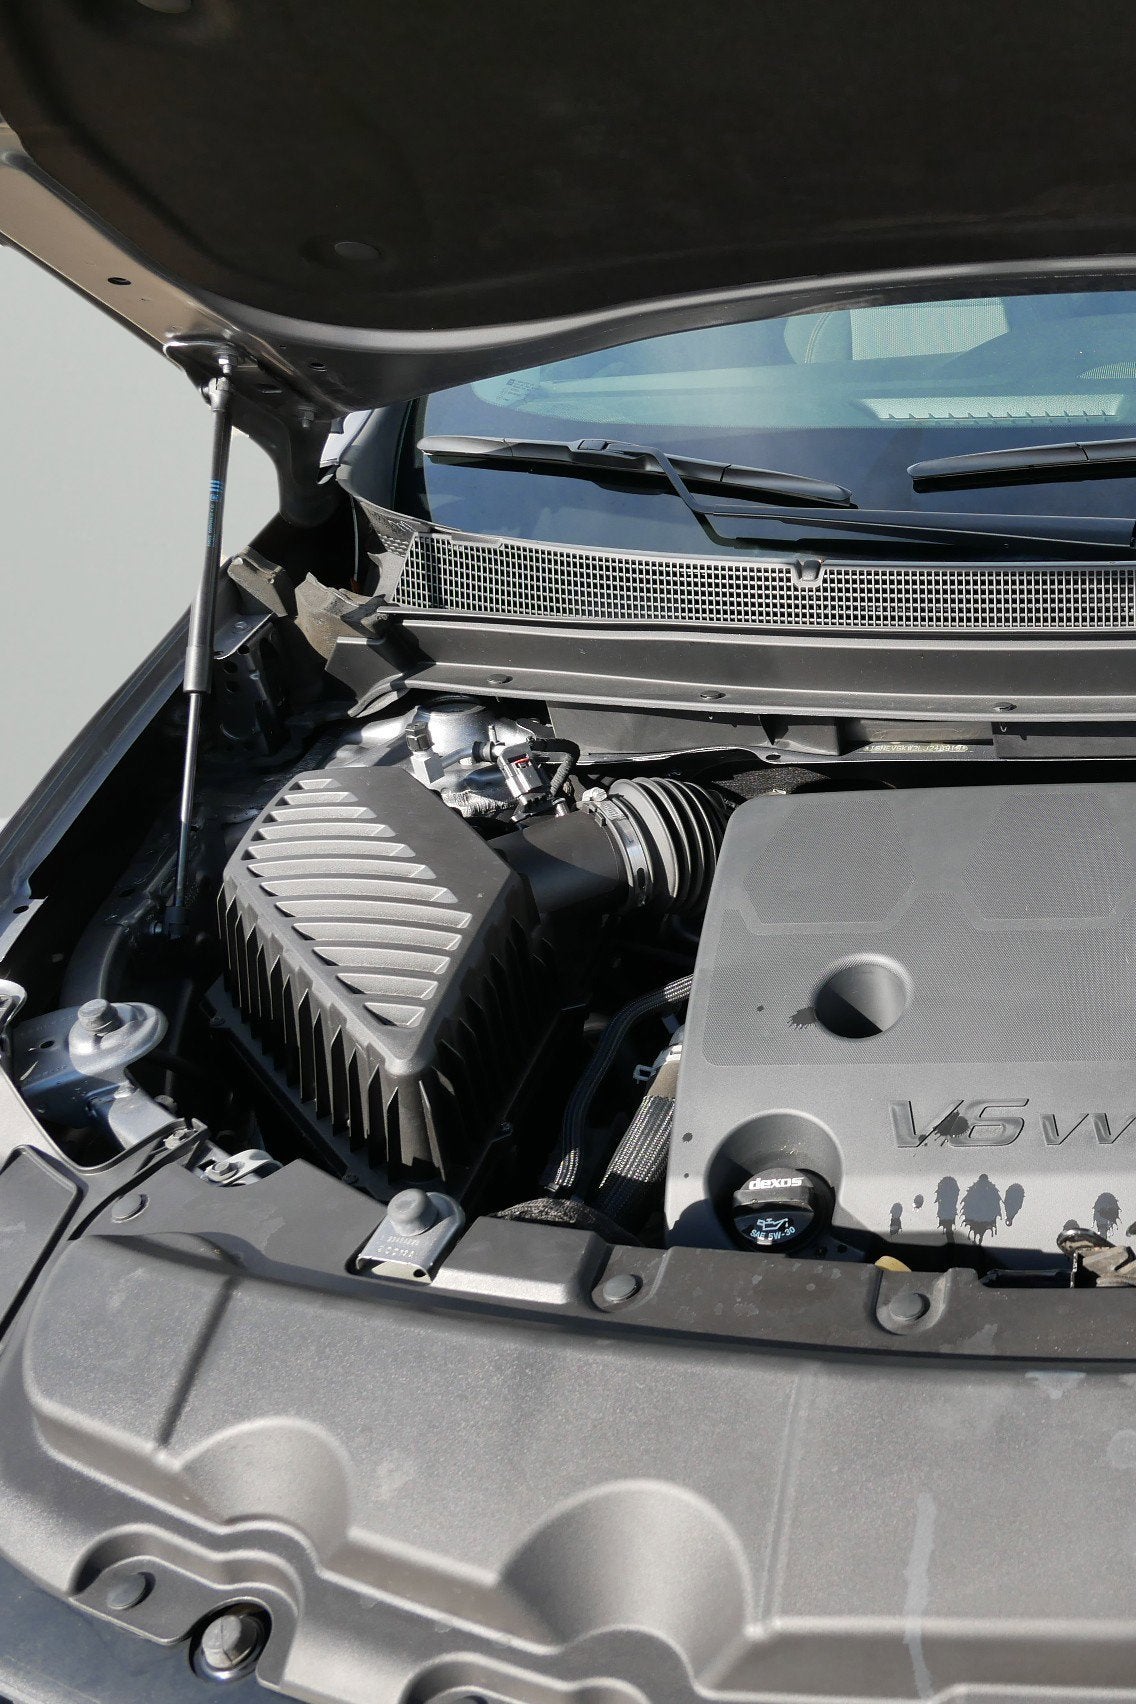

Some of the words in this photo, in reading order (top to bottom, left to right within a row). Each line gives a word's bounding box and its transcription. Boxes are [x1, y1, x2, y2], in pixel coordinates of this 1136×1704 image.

[889, 1098, 1029, 1148] V6
[748, 1177, 805, 1190] dexos
[749, 1229, 766, 1239] SAE
[768, 1226, 796, 1240] 5W-30
